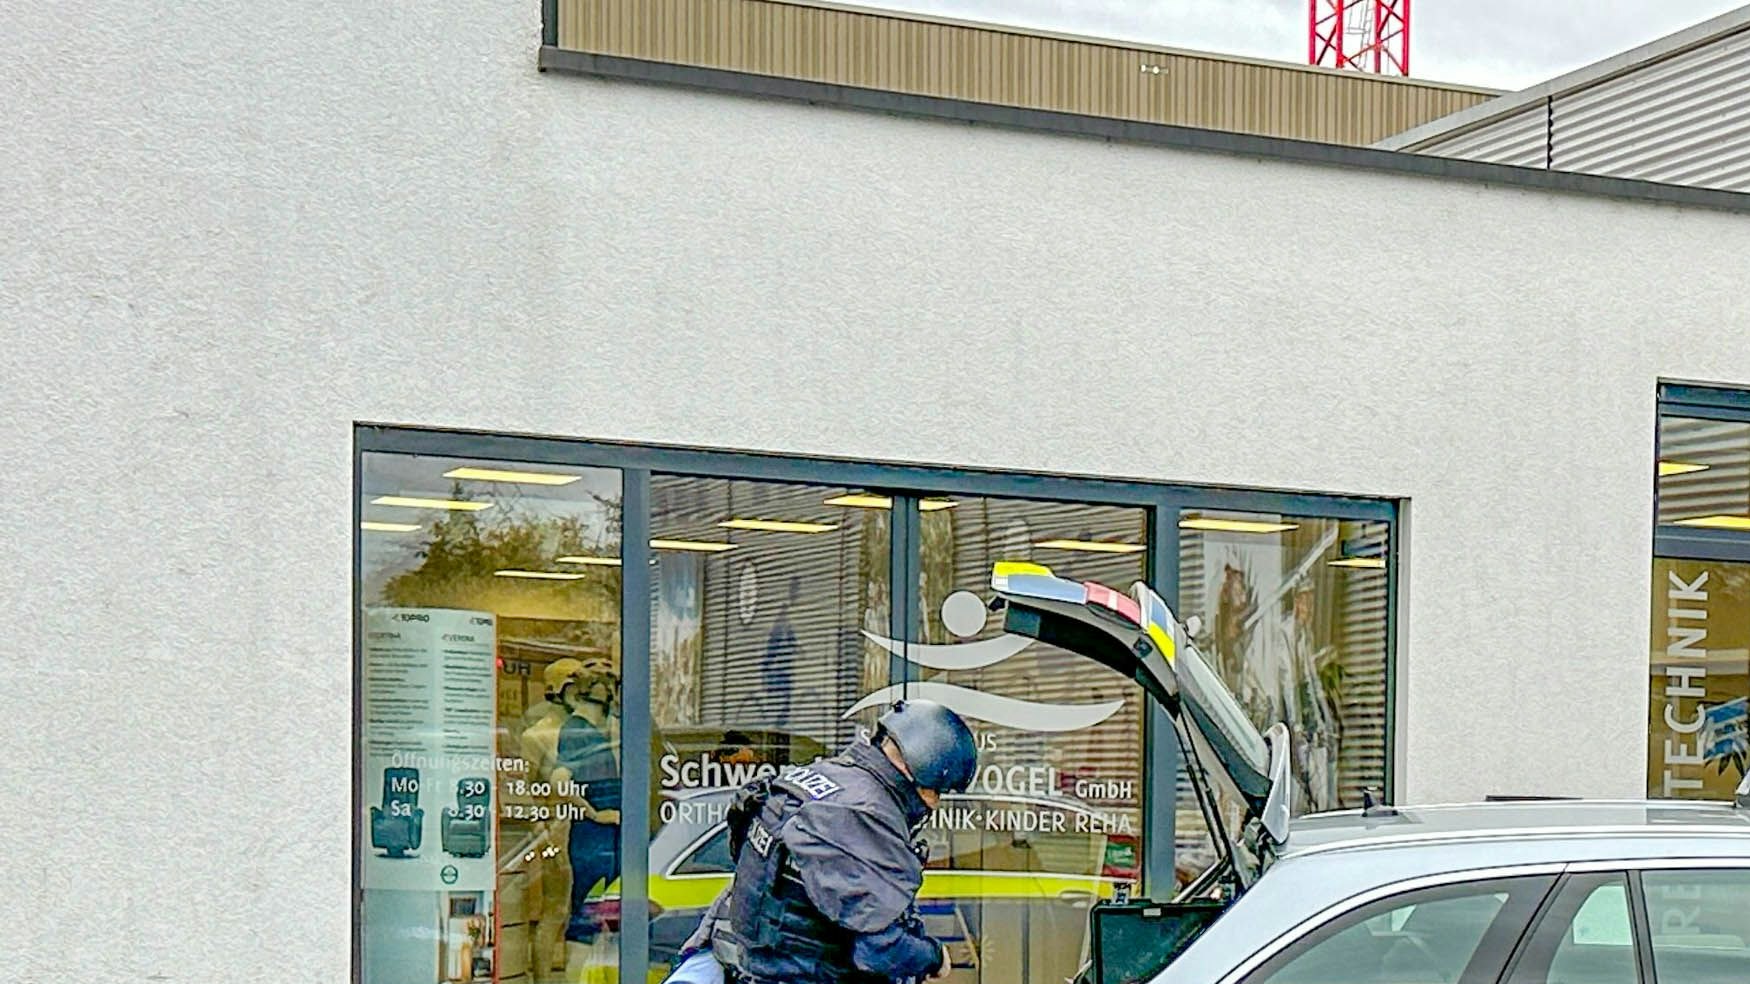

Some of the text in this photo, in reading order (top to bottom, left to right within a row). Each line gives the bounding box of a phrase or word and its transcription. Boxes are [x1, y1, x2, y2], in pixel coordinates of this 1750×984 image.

[507, 780, 551, 796] 18.00
[557, 781, 589, 797] Uhr
[1075, 780, 1132, 799] GmbH
[391, 800, 412, 817] Sa
[506, 804, 549, 822] 12.30
[556, 805, 586, 820] Uhr
[1075, 813, 1131, 834] REHA
